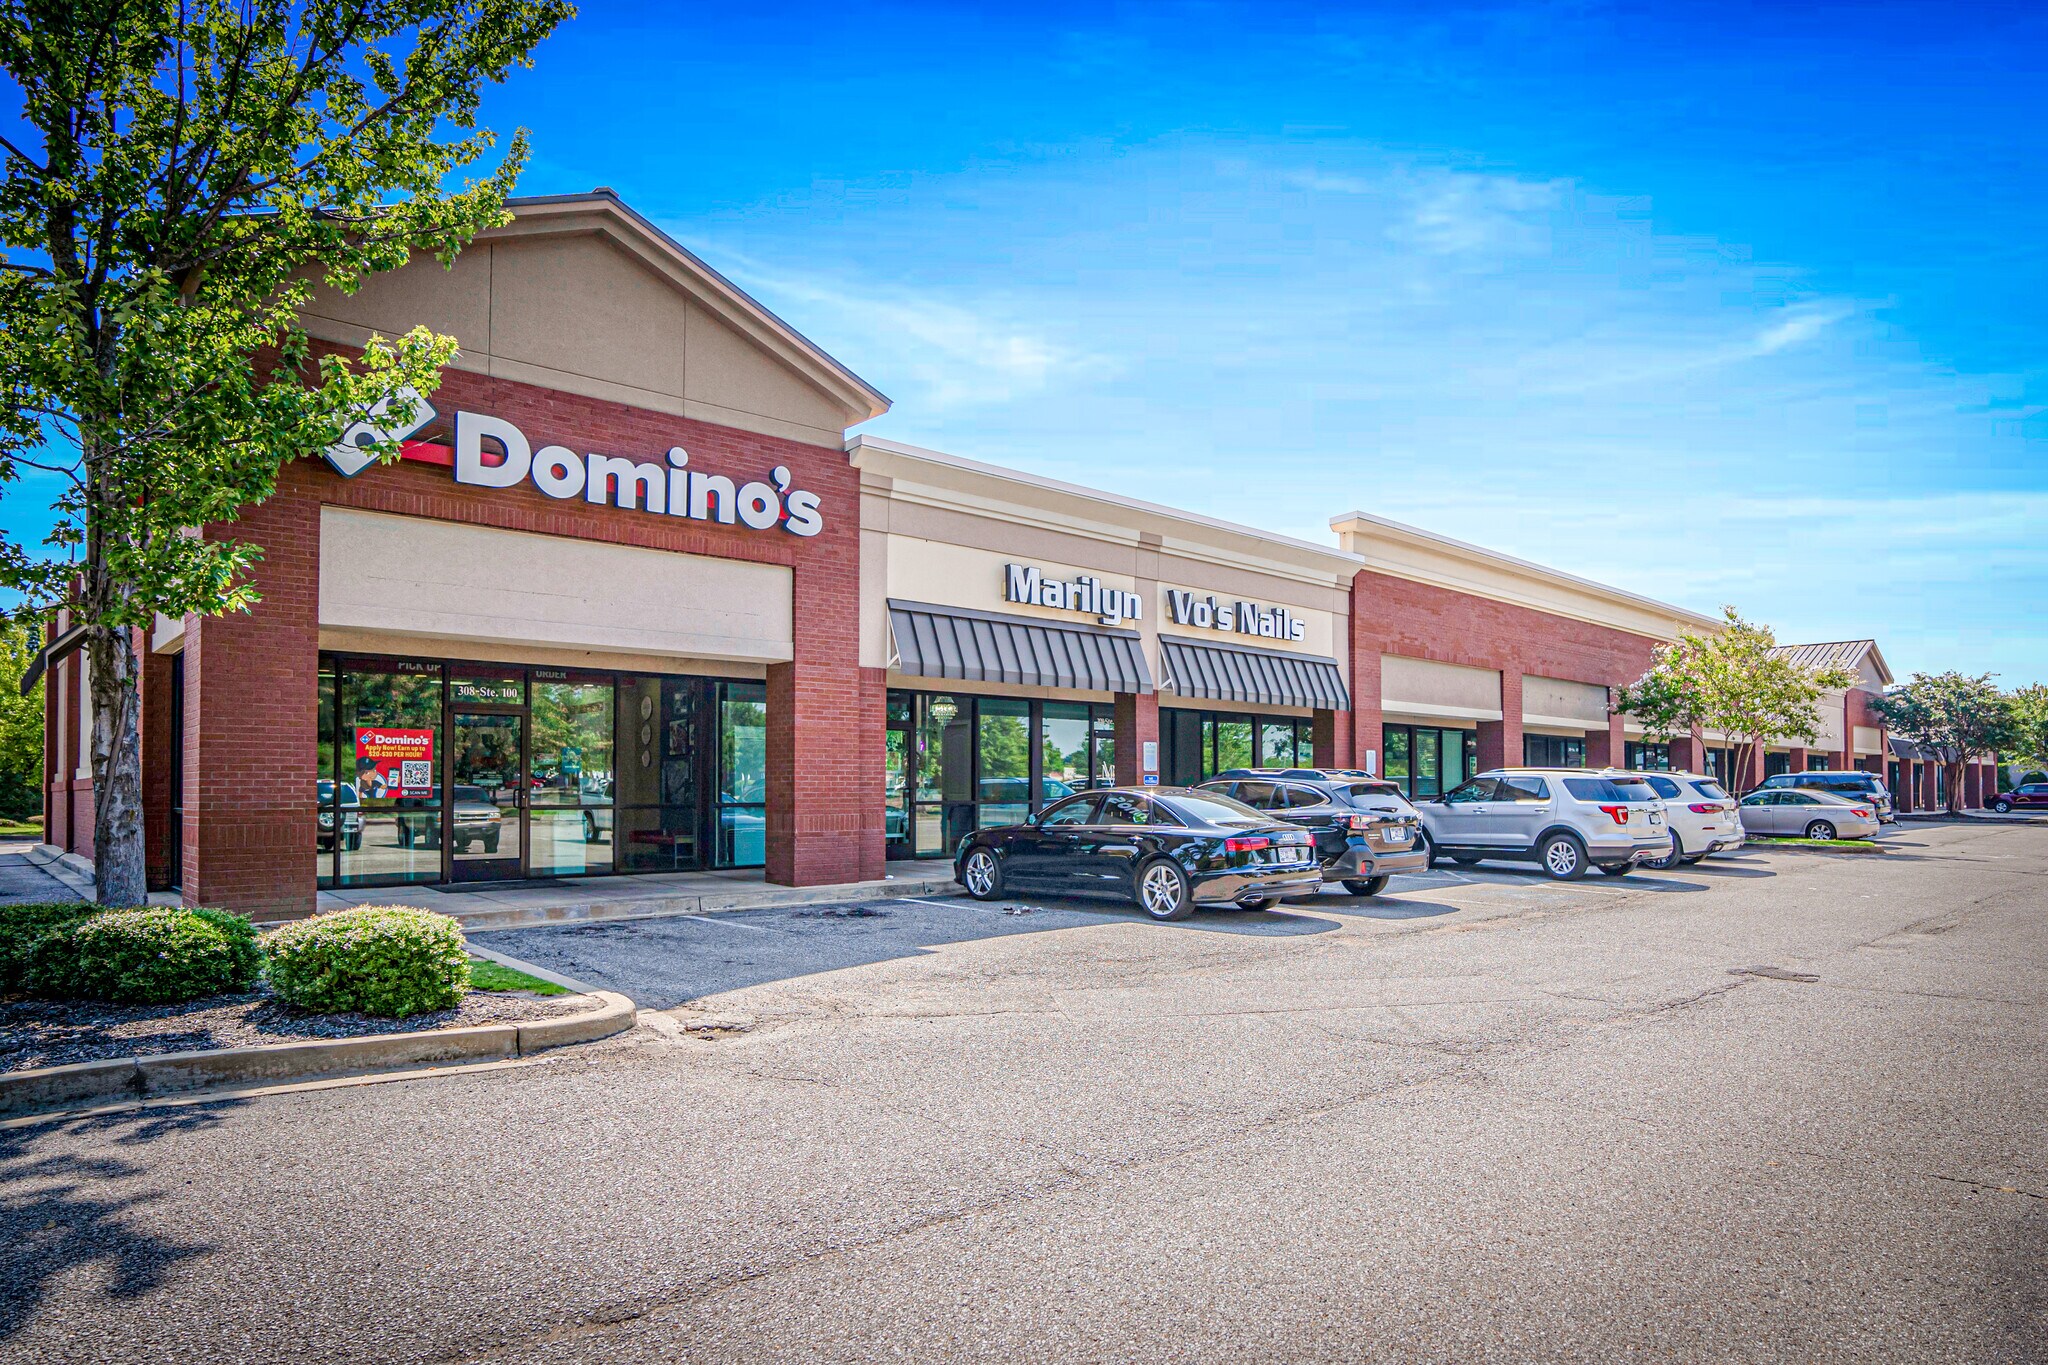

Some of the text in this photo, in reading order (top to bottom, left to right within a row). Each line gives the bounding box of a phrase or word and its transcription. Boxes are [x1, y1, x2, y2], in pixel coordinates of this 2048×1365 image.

[454, 409, 823, 537] Domino's
[1005, 563, 1143, 626] Marilyn
[1167, 589, 1305, 641] Vo's Nails
[502, 688, 518, 697] 100
[365, 744, 381, 752] Apply
[375, 734, 429, 745] Domino's
